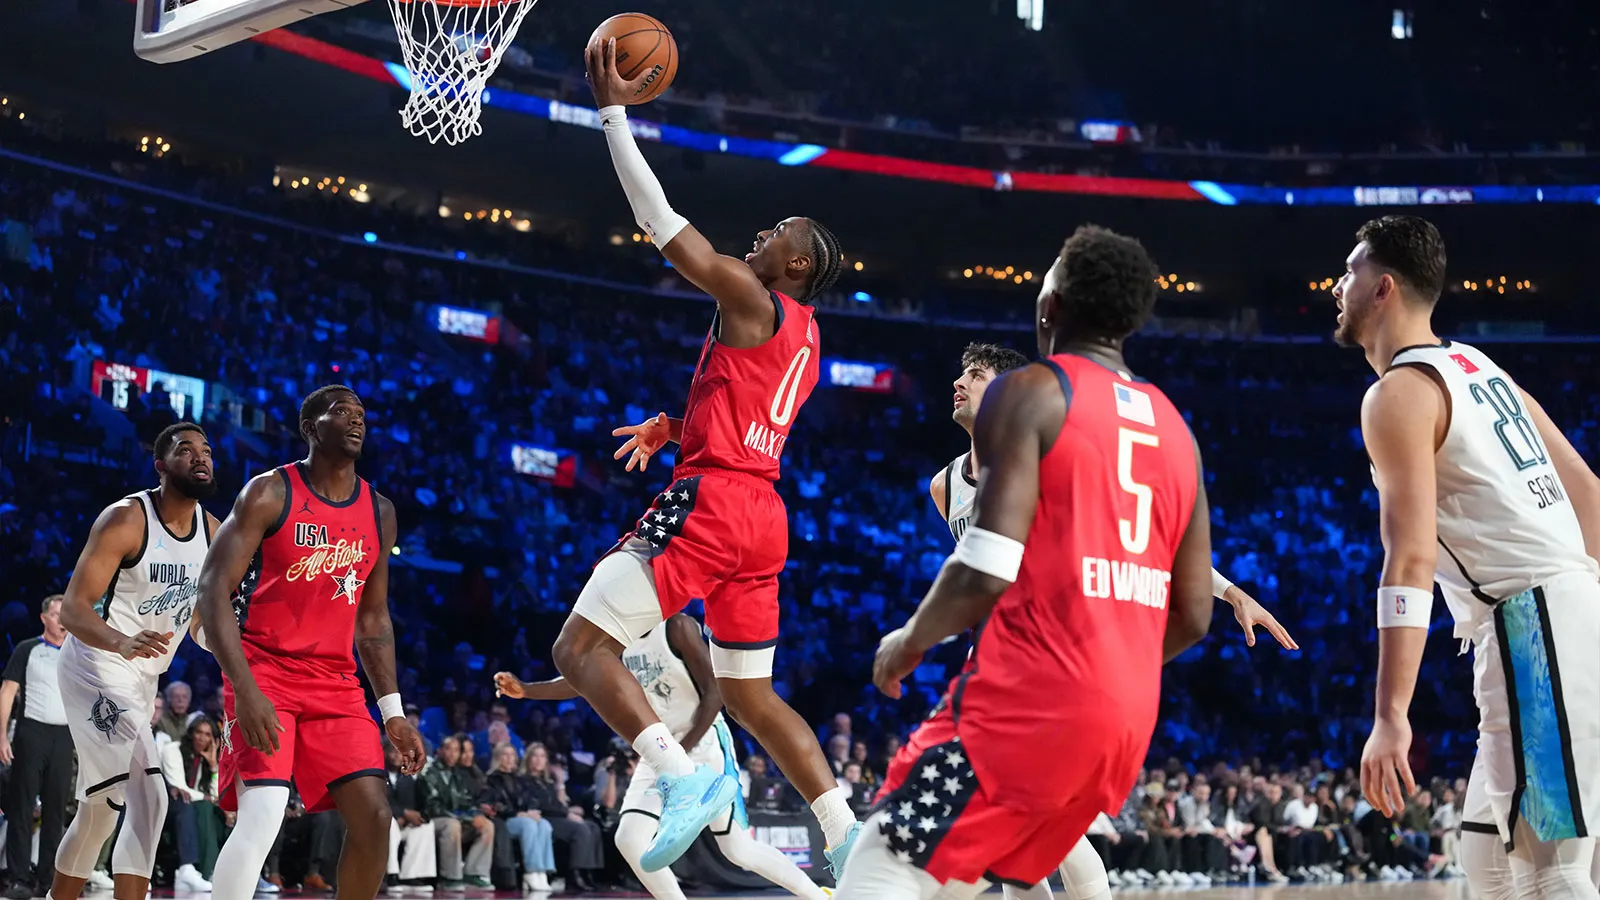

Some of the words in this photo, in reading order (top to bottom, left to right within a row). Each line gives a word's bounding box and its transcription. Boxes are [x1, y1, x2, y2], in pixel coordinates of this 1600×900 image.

[770, 345, 811, 426] 0
[1469, 376, 1547, 471] 28
[1117, 426, 1160, 555] 5
[294, 522, 330, 550] USA
[149, 562, 187, 584] WORLD
[167, 576, 199, 609] Star
[1082, 556, 1172, 610] EDWARDS
